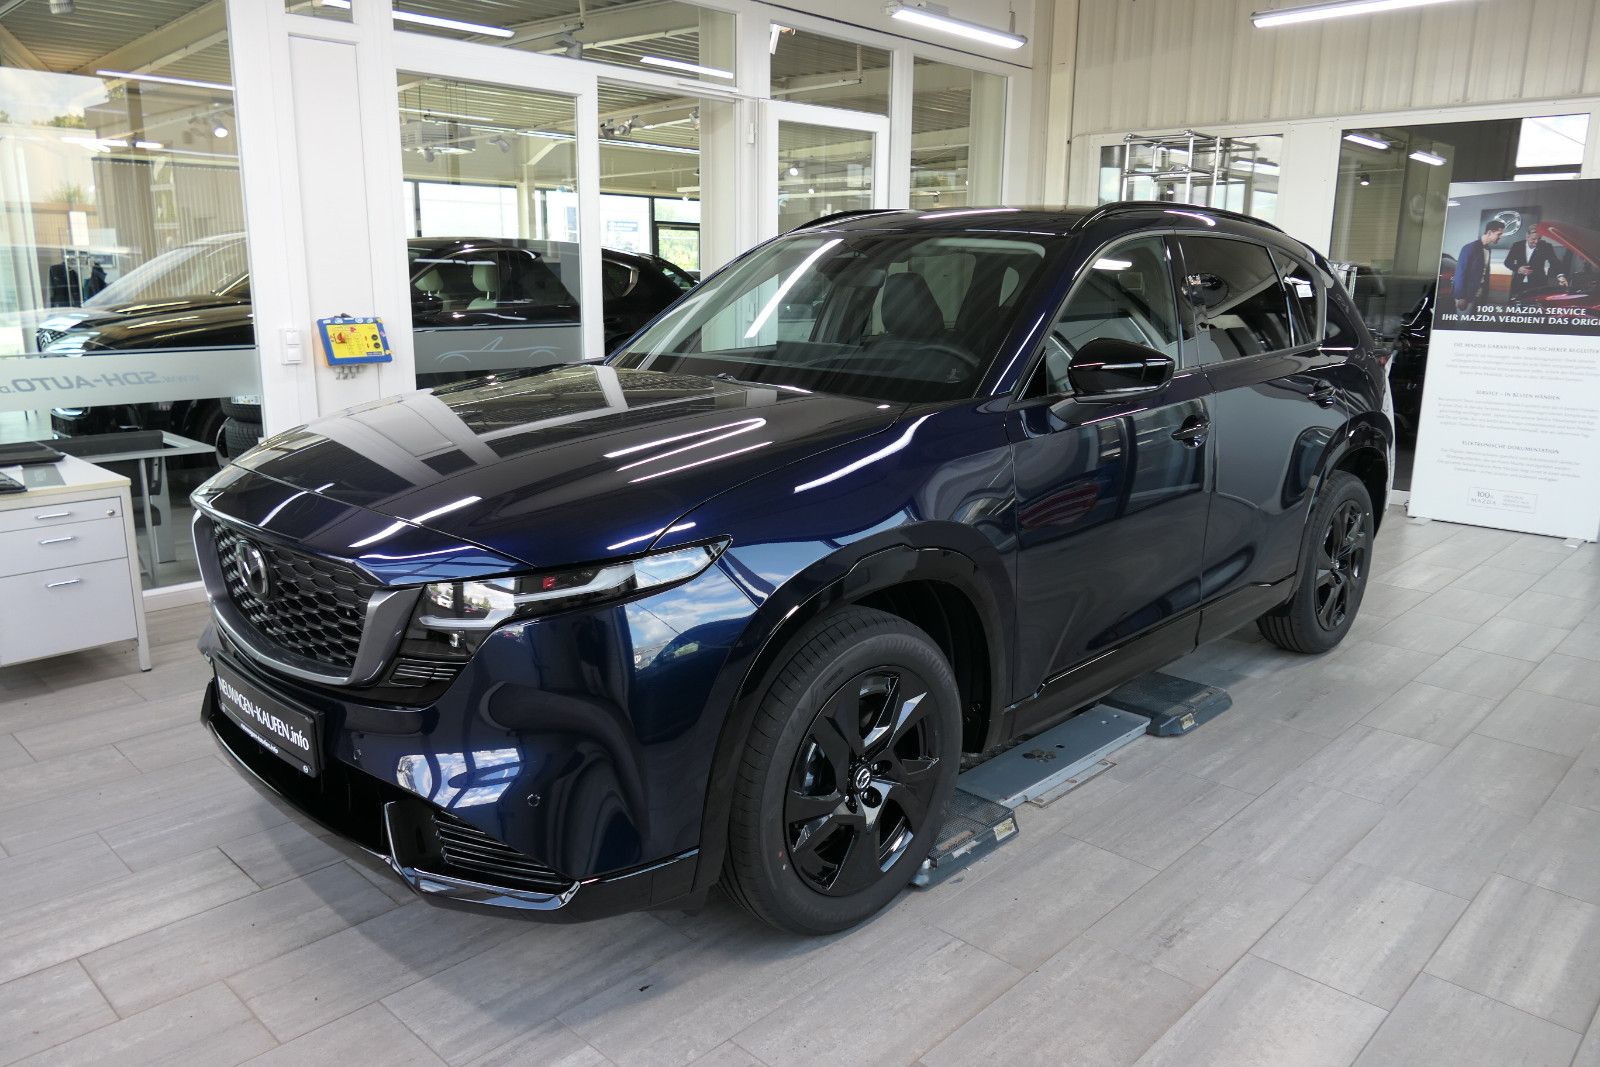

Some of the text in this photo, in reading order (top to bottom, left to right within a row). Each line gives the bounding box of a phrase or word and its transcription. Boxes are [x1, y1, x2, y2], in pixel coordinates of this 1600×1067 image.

[1506, 306, 1543, 315] MAZDA
[1545, 307, 1587, 316] SERVICE
[1442, 313, 1459, 321] IHR
[1460, 314, 1496, 323] MAZDA
[1498, 315, 1546, 324] VERDIENT
[1547, 317, 1569, 325] DAS
